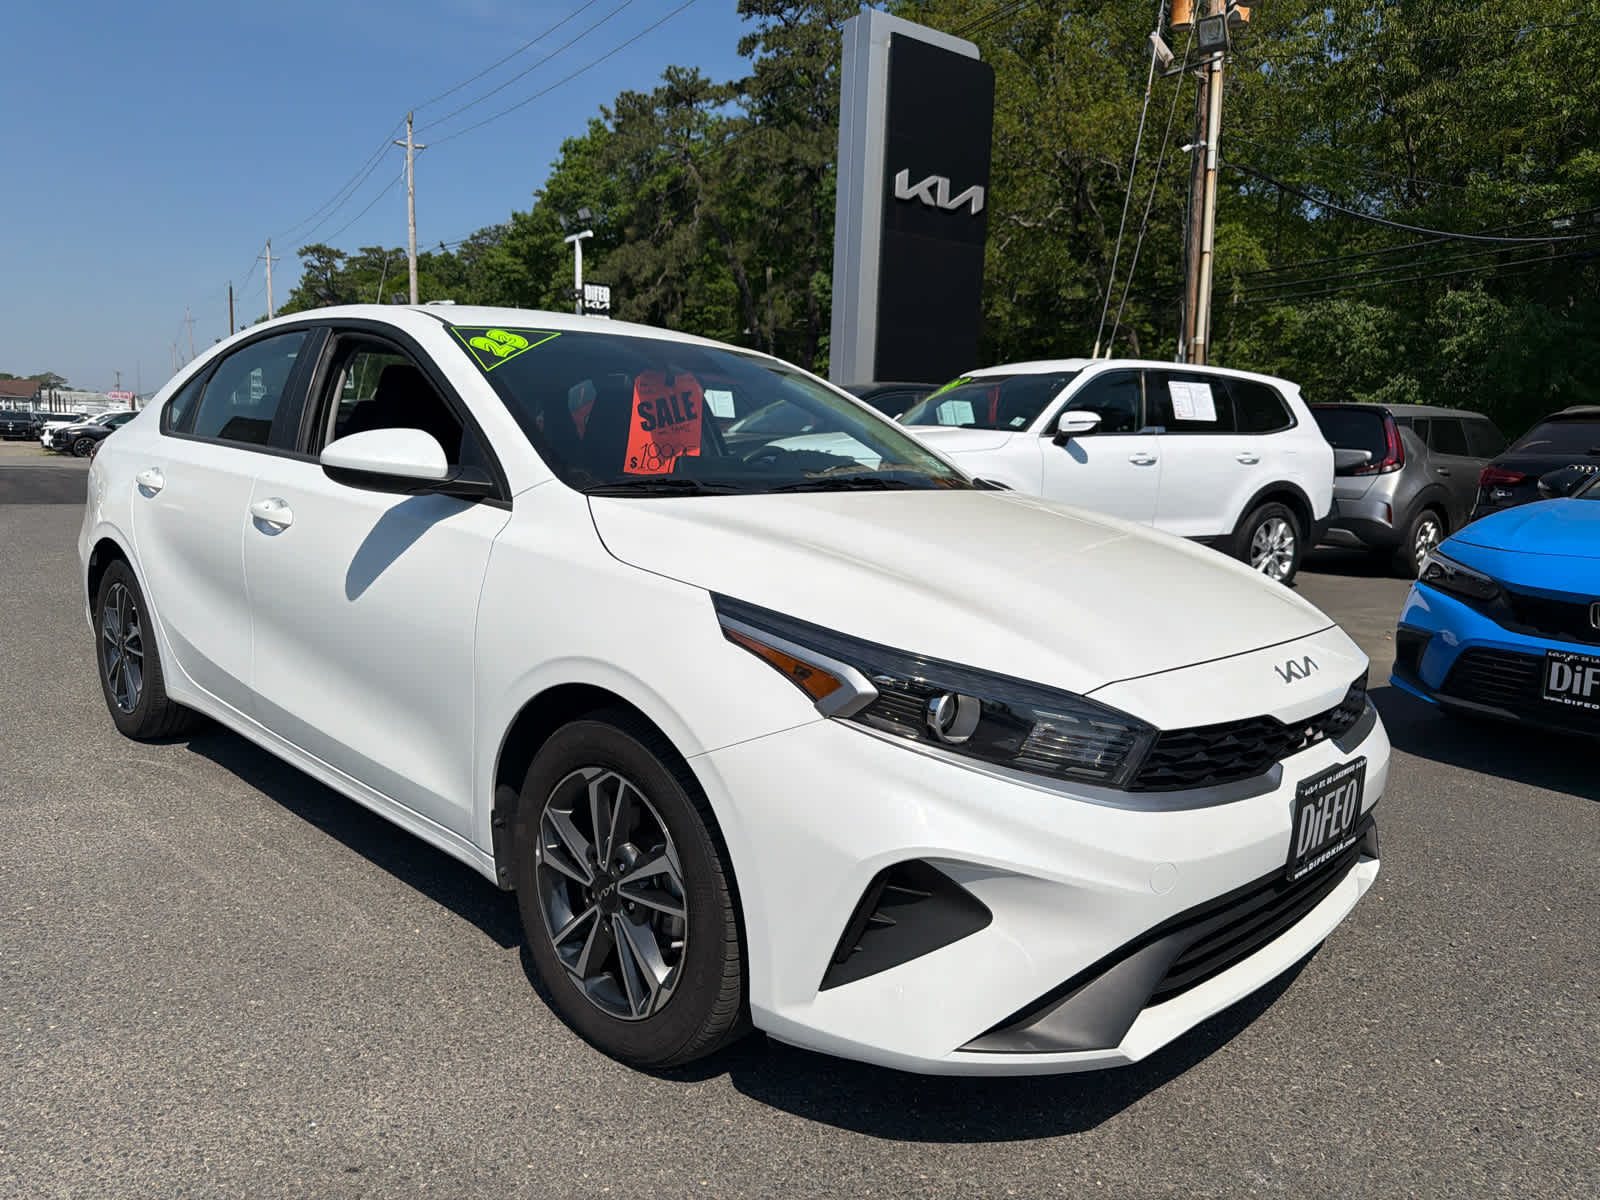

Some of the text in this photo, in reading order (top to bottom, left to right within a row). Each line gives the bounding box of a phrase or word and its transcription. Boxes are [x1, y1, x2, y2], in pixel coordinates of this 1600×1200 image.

[895, 168, 984, 215] KIA
[637, 391, 698, 432] SALE
[1274, 655, 1319, 684] KIA
